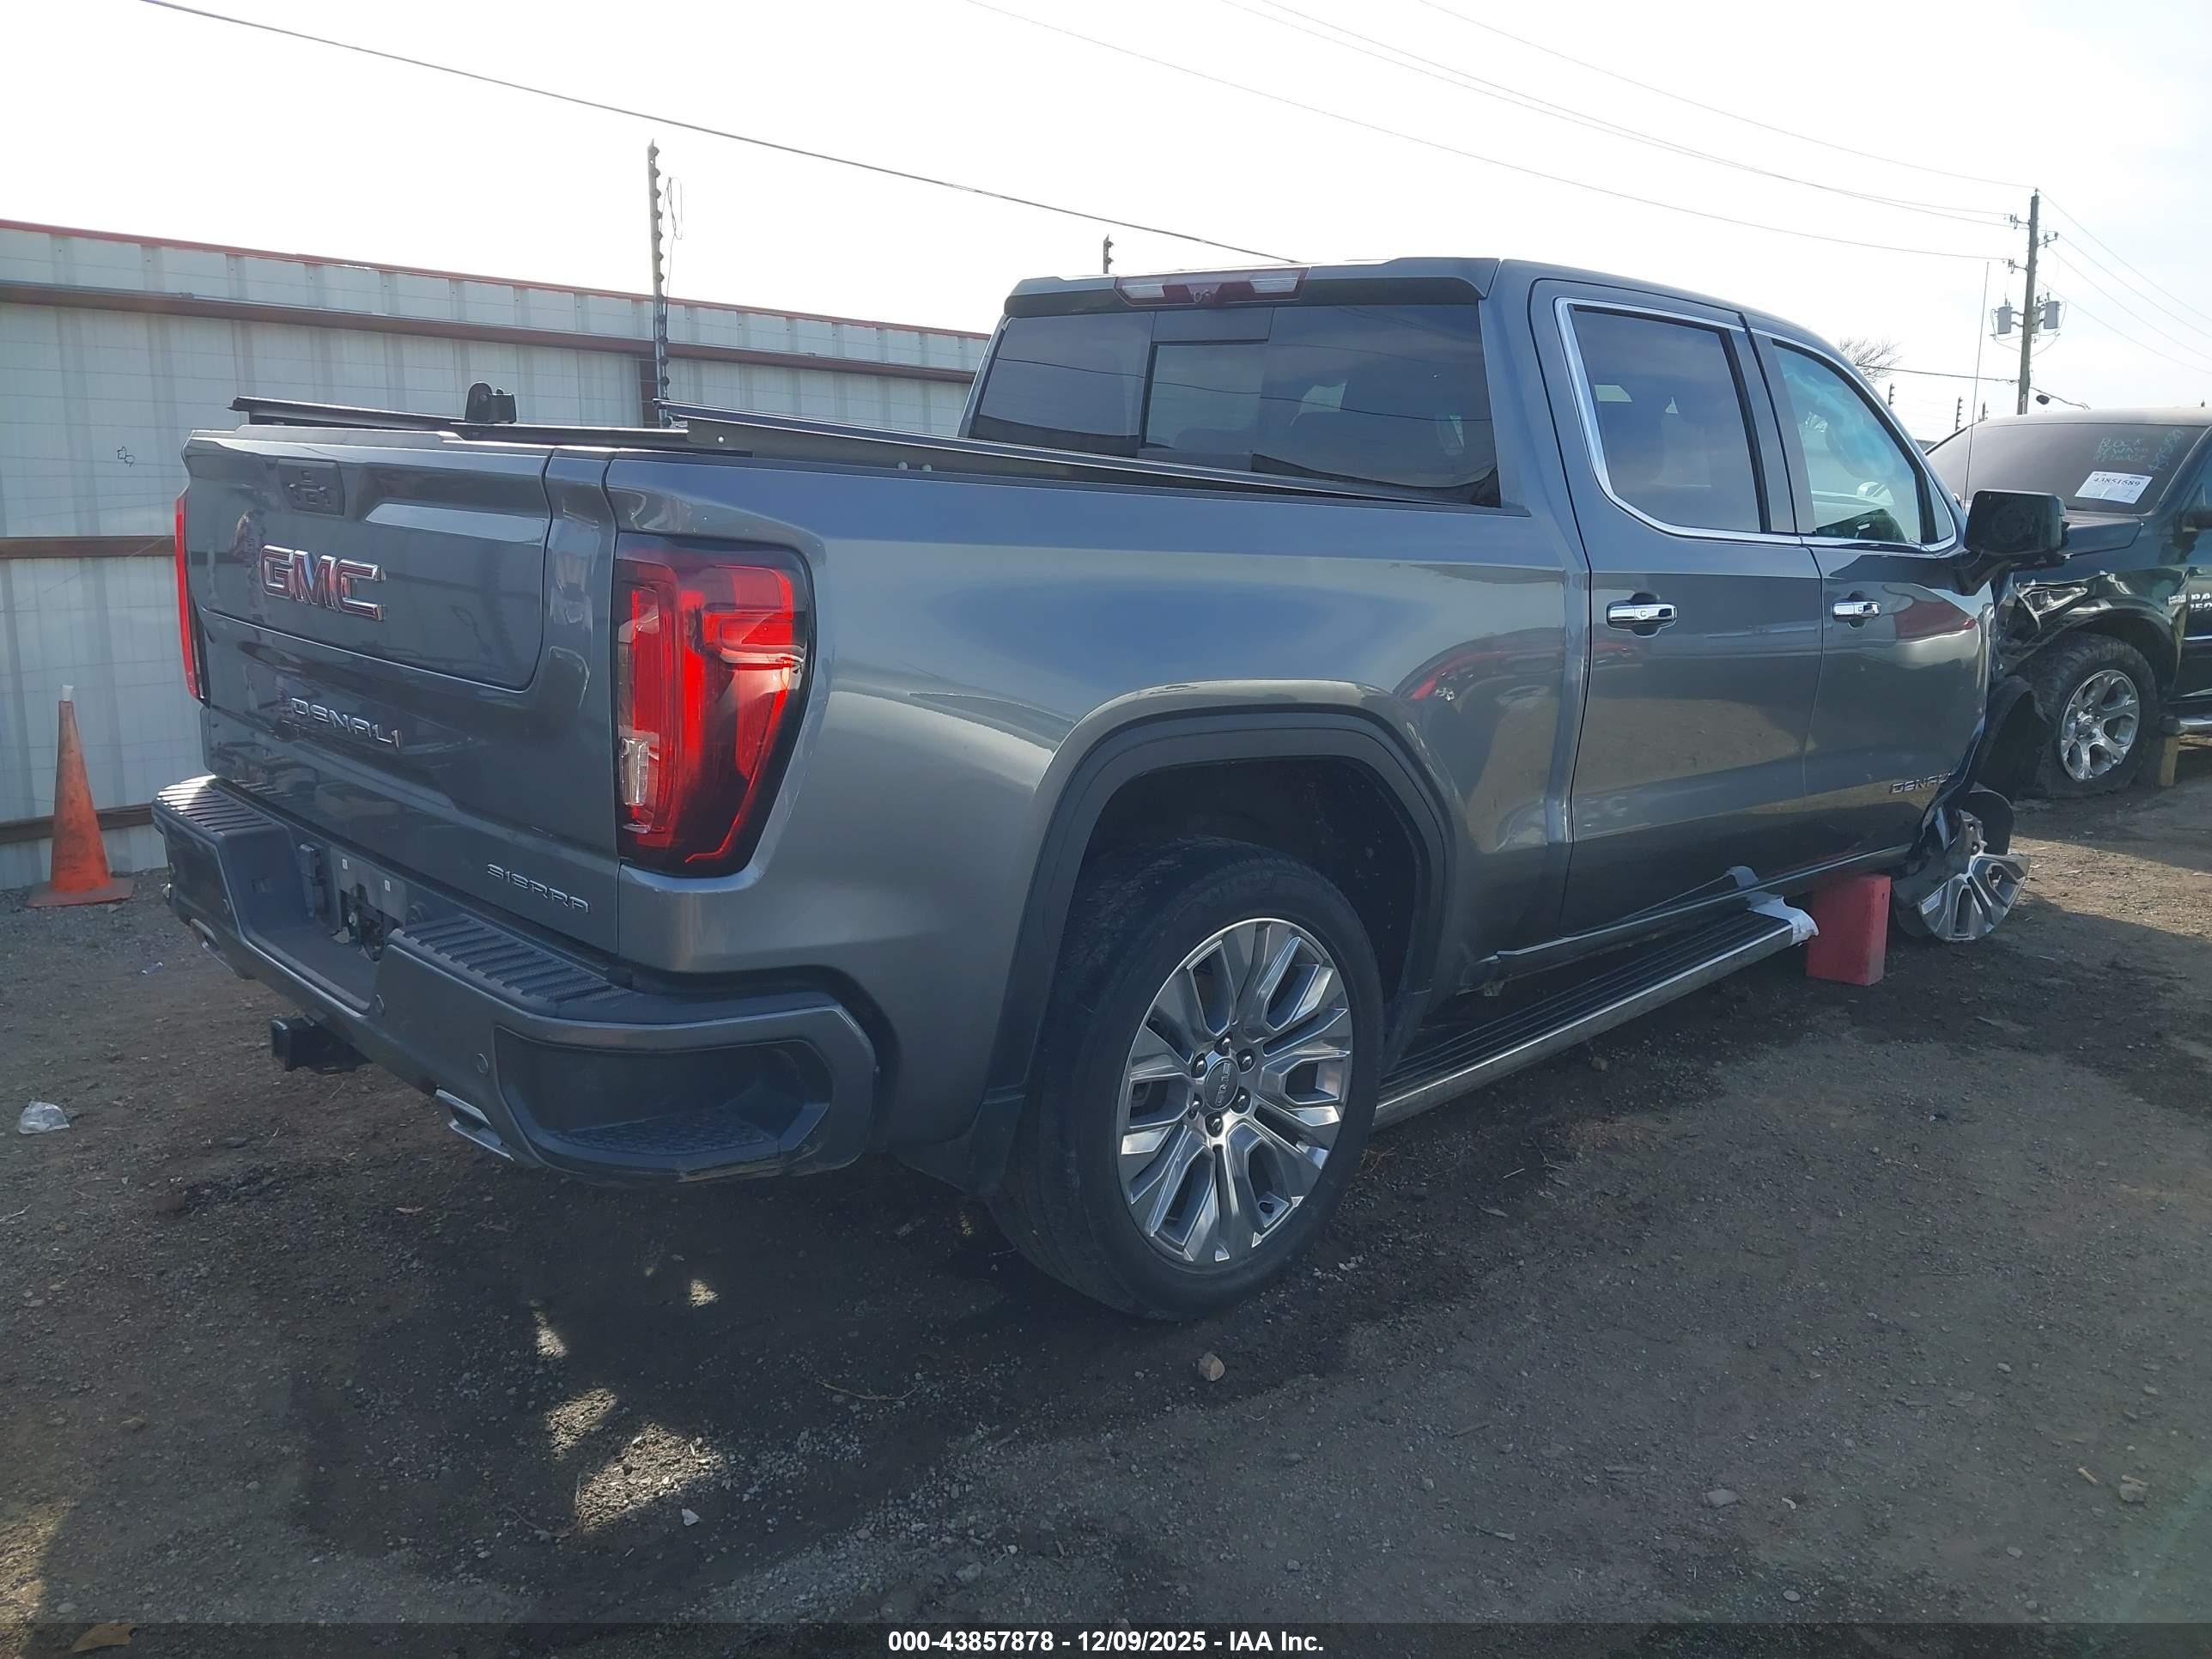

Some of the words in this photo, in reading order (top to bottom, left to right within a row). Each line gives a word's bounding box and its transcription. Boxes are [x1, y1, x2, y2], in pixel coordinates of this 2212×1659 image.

[260, 544, 386, 622] GMC
[2191, 592, 2212, 602] RA
[290, 697, 403, 749] DENALI
[487, 863, 589, 913] SIERRA
